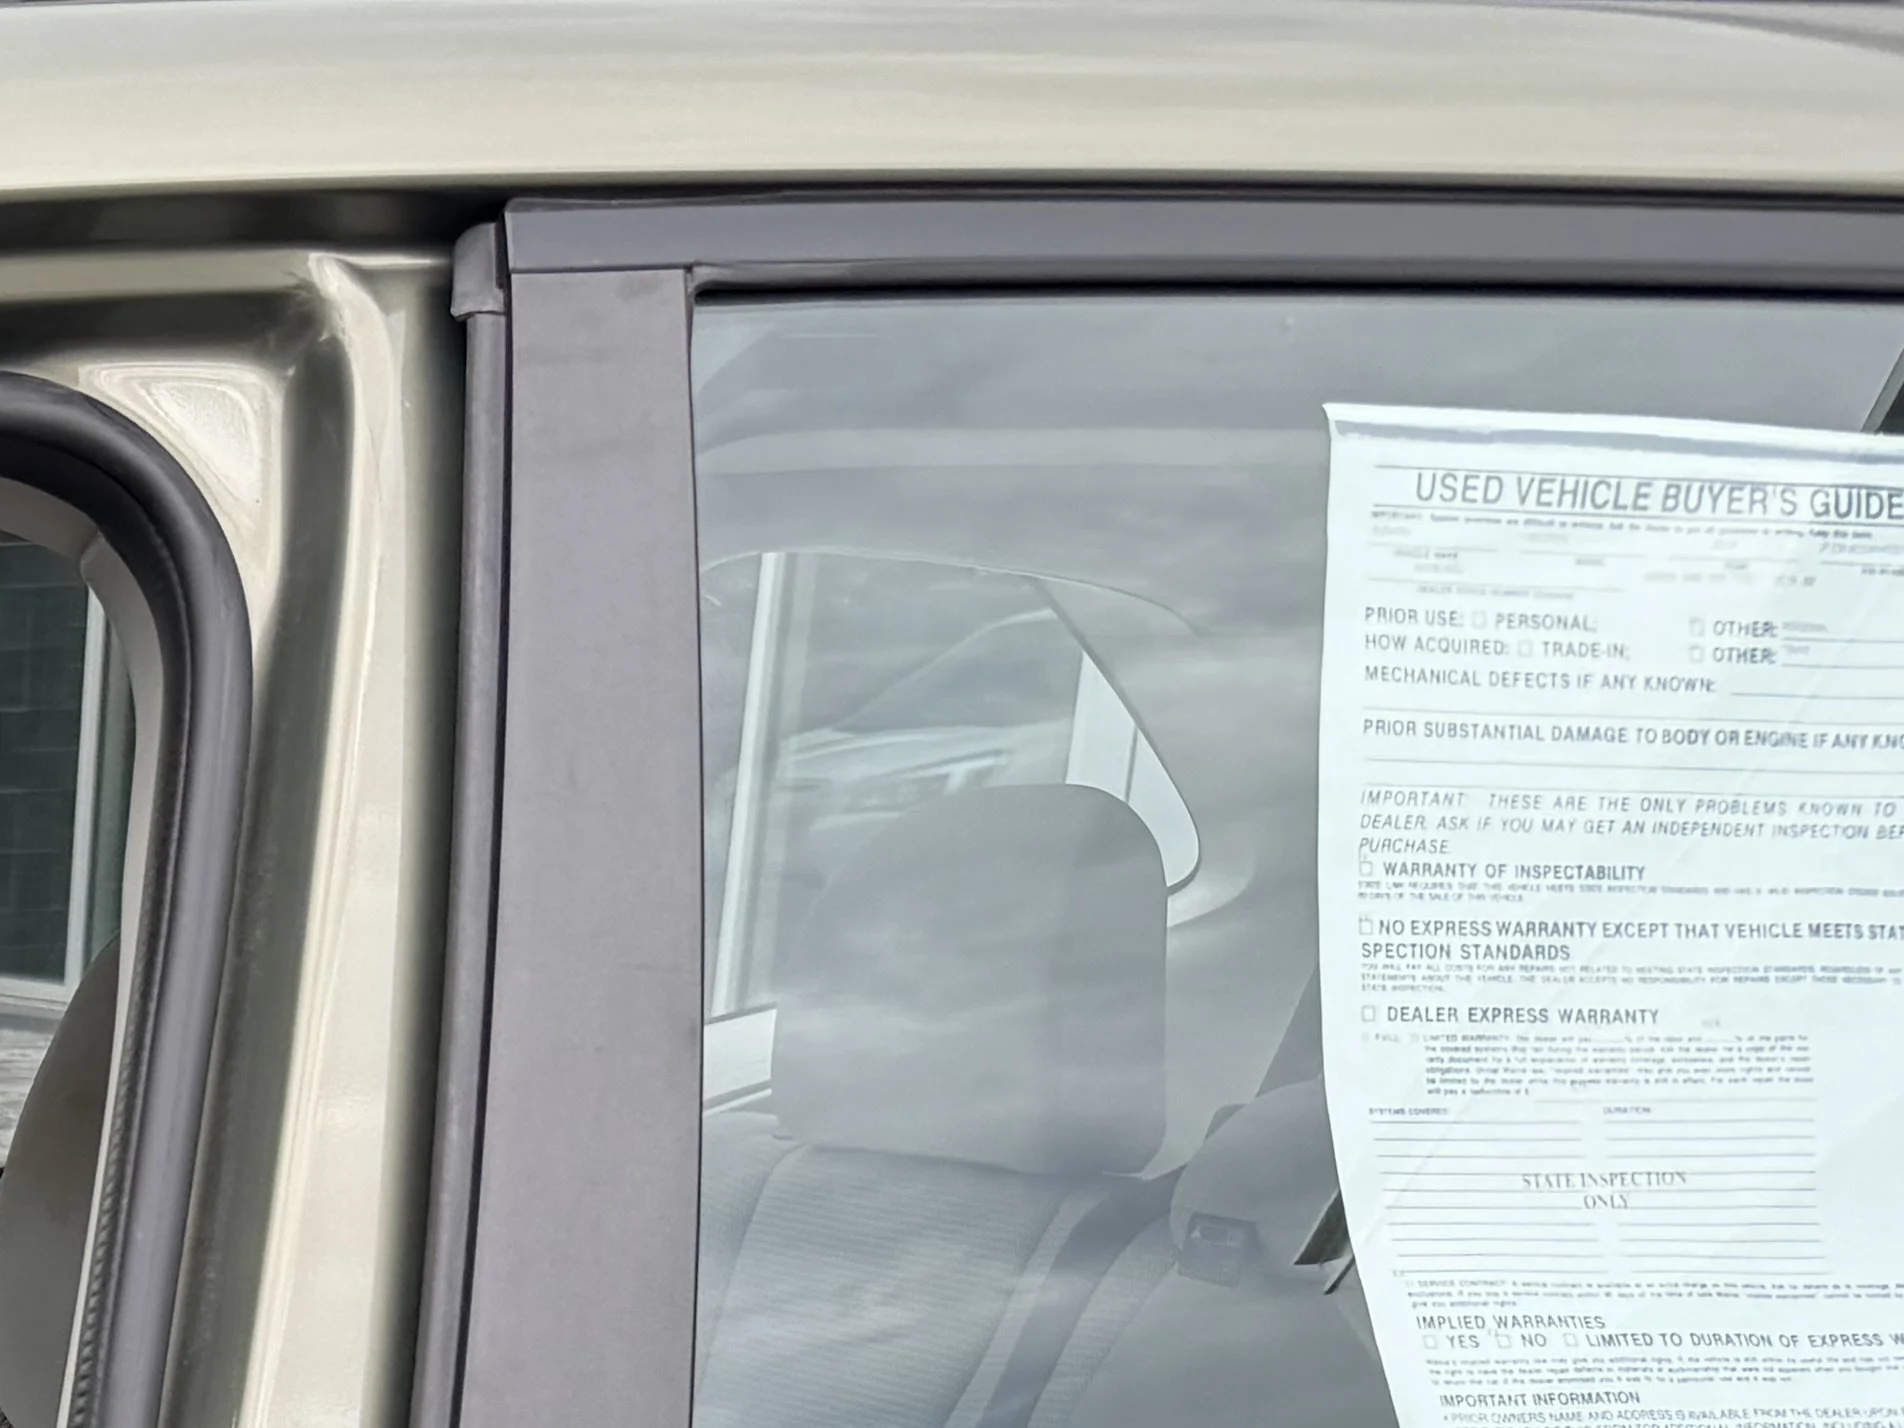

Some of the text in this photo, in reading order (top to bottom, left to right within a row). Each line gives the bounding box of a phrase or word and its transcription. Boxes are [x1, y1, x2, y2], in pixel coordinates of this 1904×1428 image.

[1417, 472, 1904, 520] USED VEHICLE BUYER'S GUIDE
[1364, 607, 1418, 625] PRIOR
[1426, 610, 1464, 627] USE:
[1365, 634, 1407, 650] HOW
[1414, 636, 1510, 656] ACQUIRED:
[1364, 665, 1481, 686] MECHANICAL
[1489, 670, 1571, 689] DEFECTS
[1577, 674, 1592, 689] IF
[1600, 674, 1637, 690] ANY
[1363, 718, 1417, 736] PRIOR
[1423, 721, 1545, 741] SUBSTANTIAL
[1551, 725, 1628, 743] DAMAGE
[1636, 728, 1658, 745] TO
[1662, 728, 1711, 746] BODY
[1715, 730, 1740, 746] OR
[1744, 730, 1809, 748] ENGINE
[1813, 732, 1828, 748] IF
[1831, 733, 1868, 749] ANY
[1490, 793, 1542, 810] THESE
[1553, 796, 1587, 811] ARE
[1598, 796, 1631, 812] THE
[1641, 797, 1687, 813] ONLY
[1695, 799, 1787, 815] PROBLEMS
[1798, 801, 1862, 817] KNOWN
[1874, 802, 1897, 817] TO
[1437, 816, 1469, 831] ASK
[1477, 816, 1491, 831] IF
[1502, 818, 1533, 833] YOU
[1542, 818, 1577, 833] MAY
[1584, 819, 1616, 834] GET
[1622, 820, 1646, 835] AN
[1652, 821, 1764, 838] INDEPENDENT
[1772, 824, 1869, 839] INSPECTION
[1383, 861, 1645, 881] WARRANTY OF INSPECTABILITY
[1379, 919, 1405, 935] NO
[1411, 920, 1492, 936] EXPRESS
[1496, 920, 1597, 937] WARRANTY
[1602, 921, 1669, 938] EXCEPT
[1675, 922, 1719, 939] THAT
[1725, 922, 1803, 939] VEHICLE
[1809, 922, 1863, 939] MEETS
[1362, 942, 1571, 961] SPECTION STANDARDS
[1387, 1006, 1659, 1024] DEALER EXPRESS WARRANTY
[1522, 1172, 1687, 1189] STATE INSPECTION
[1583, 1194, 1630, 1210] ONLY
[1416, 1314, 1606, 1330] IMPLIED WARRANTIES
[1446, 1335, 1480, 1349] YES
[1521, 1333, 1547, 1347] NO
[1586, 1333, 1654, 1347] LIMITED
[1658, 1333, 1683, 1347] TO
[1690, 1332, 1773, 1348] DURATION
[1779, 1333, 1800, 1348] OF
[1808, 1333, 1884, 1348] EXPRESS
[1440, 1391, 1641, 1408] IMPORTANT INFORMATION
